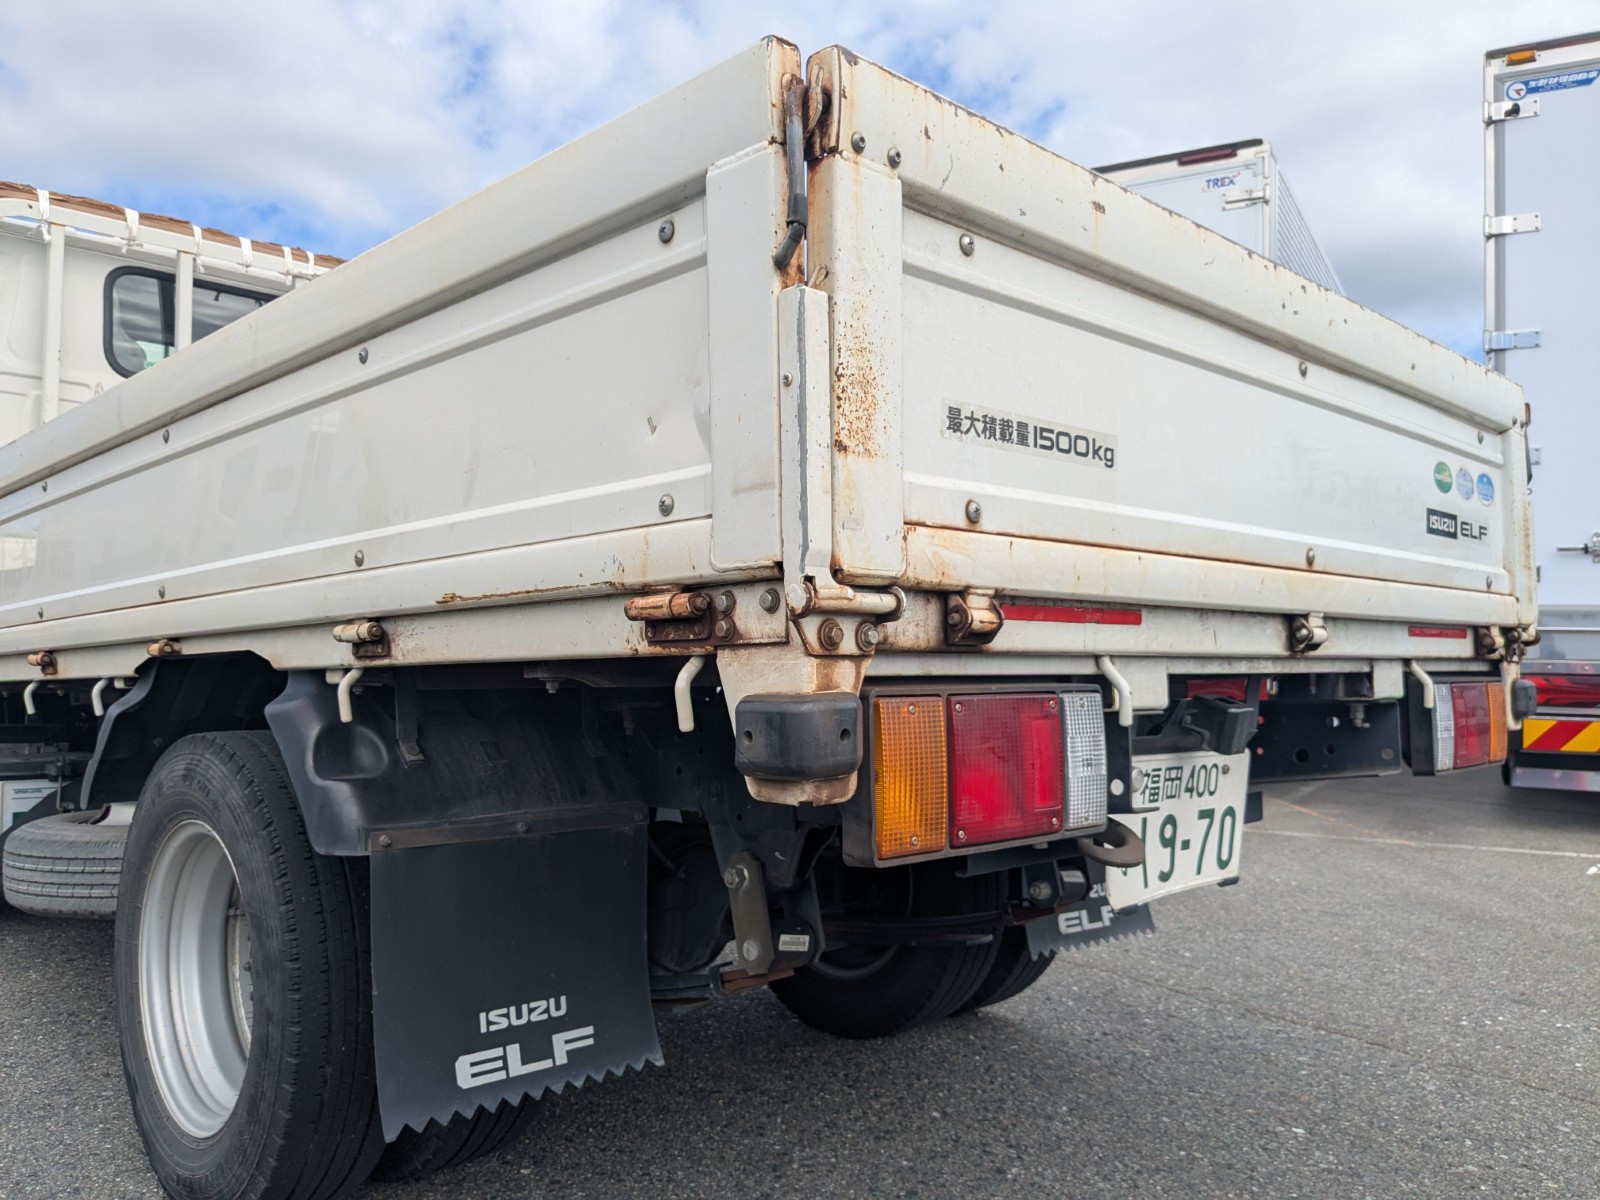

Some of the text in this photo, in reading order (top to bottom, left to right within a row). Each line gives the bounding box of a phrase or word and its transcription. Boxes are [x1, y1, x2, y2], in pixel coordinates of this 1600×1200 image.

[1429, 514, 1488, 541] ISUZU ELF
[1057, 904, 1114, 935] ELF
[479, 995, 568, 1034] ISUZU
[454, 1025, 595, 1090] ELF
